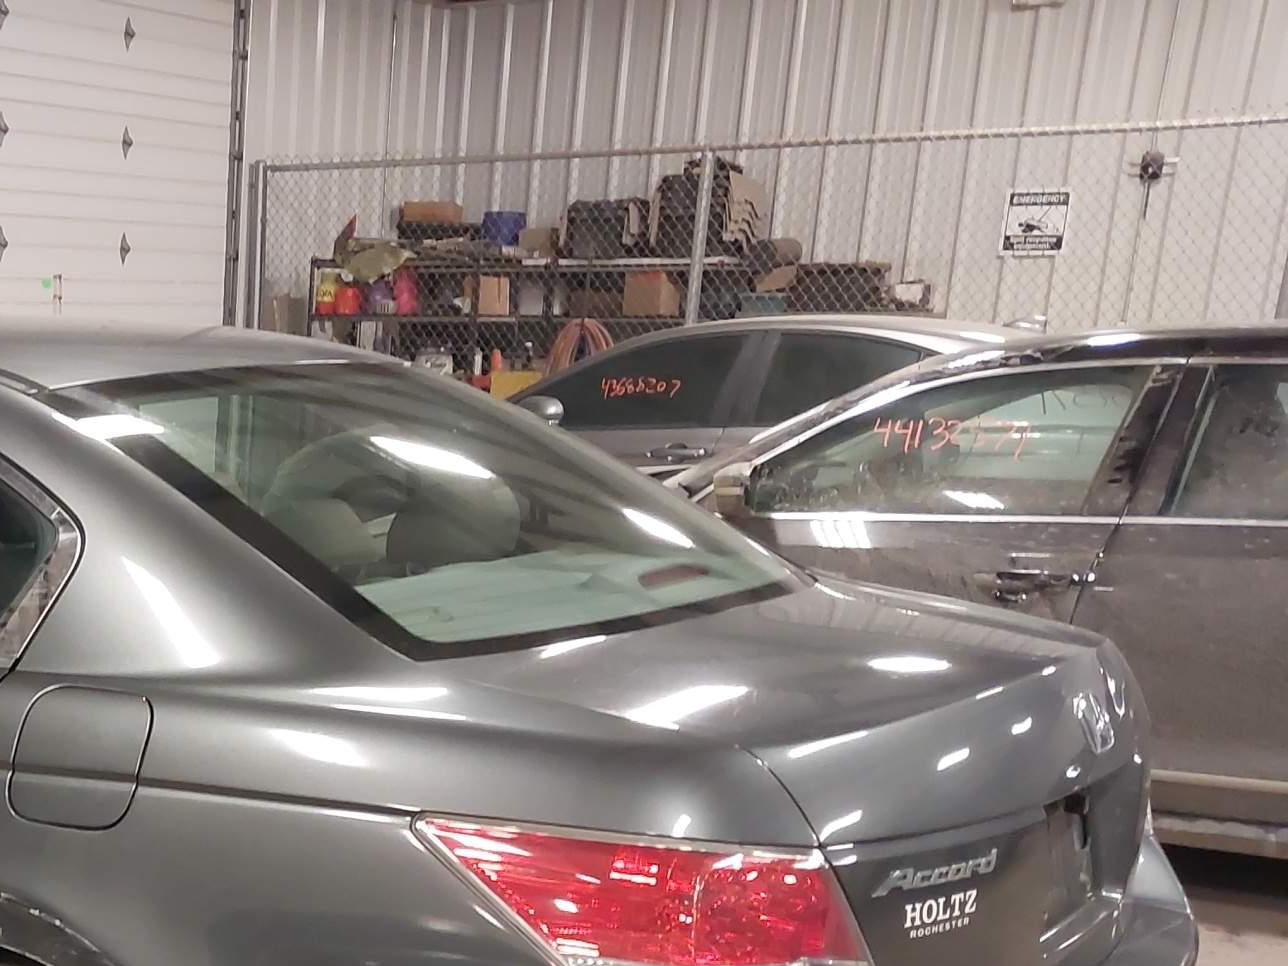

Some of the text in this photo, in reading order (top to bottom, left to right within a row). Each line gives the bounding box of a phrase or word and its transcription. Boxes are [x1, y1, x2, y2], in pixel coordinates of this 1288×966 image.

[871, 848, 998, 898] Accord
[904, 888, 977, 928] HOLTZ
[909, 916, 970, 939] ROCHESTER
